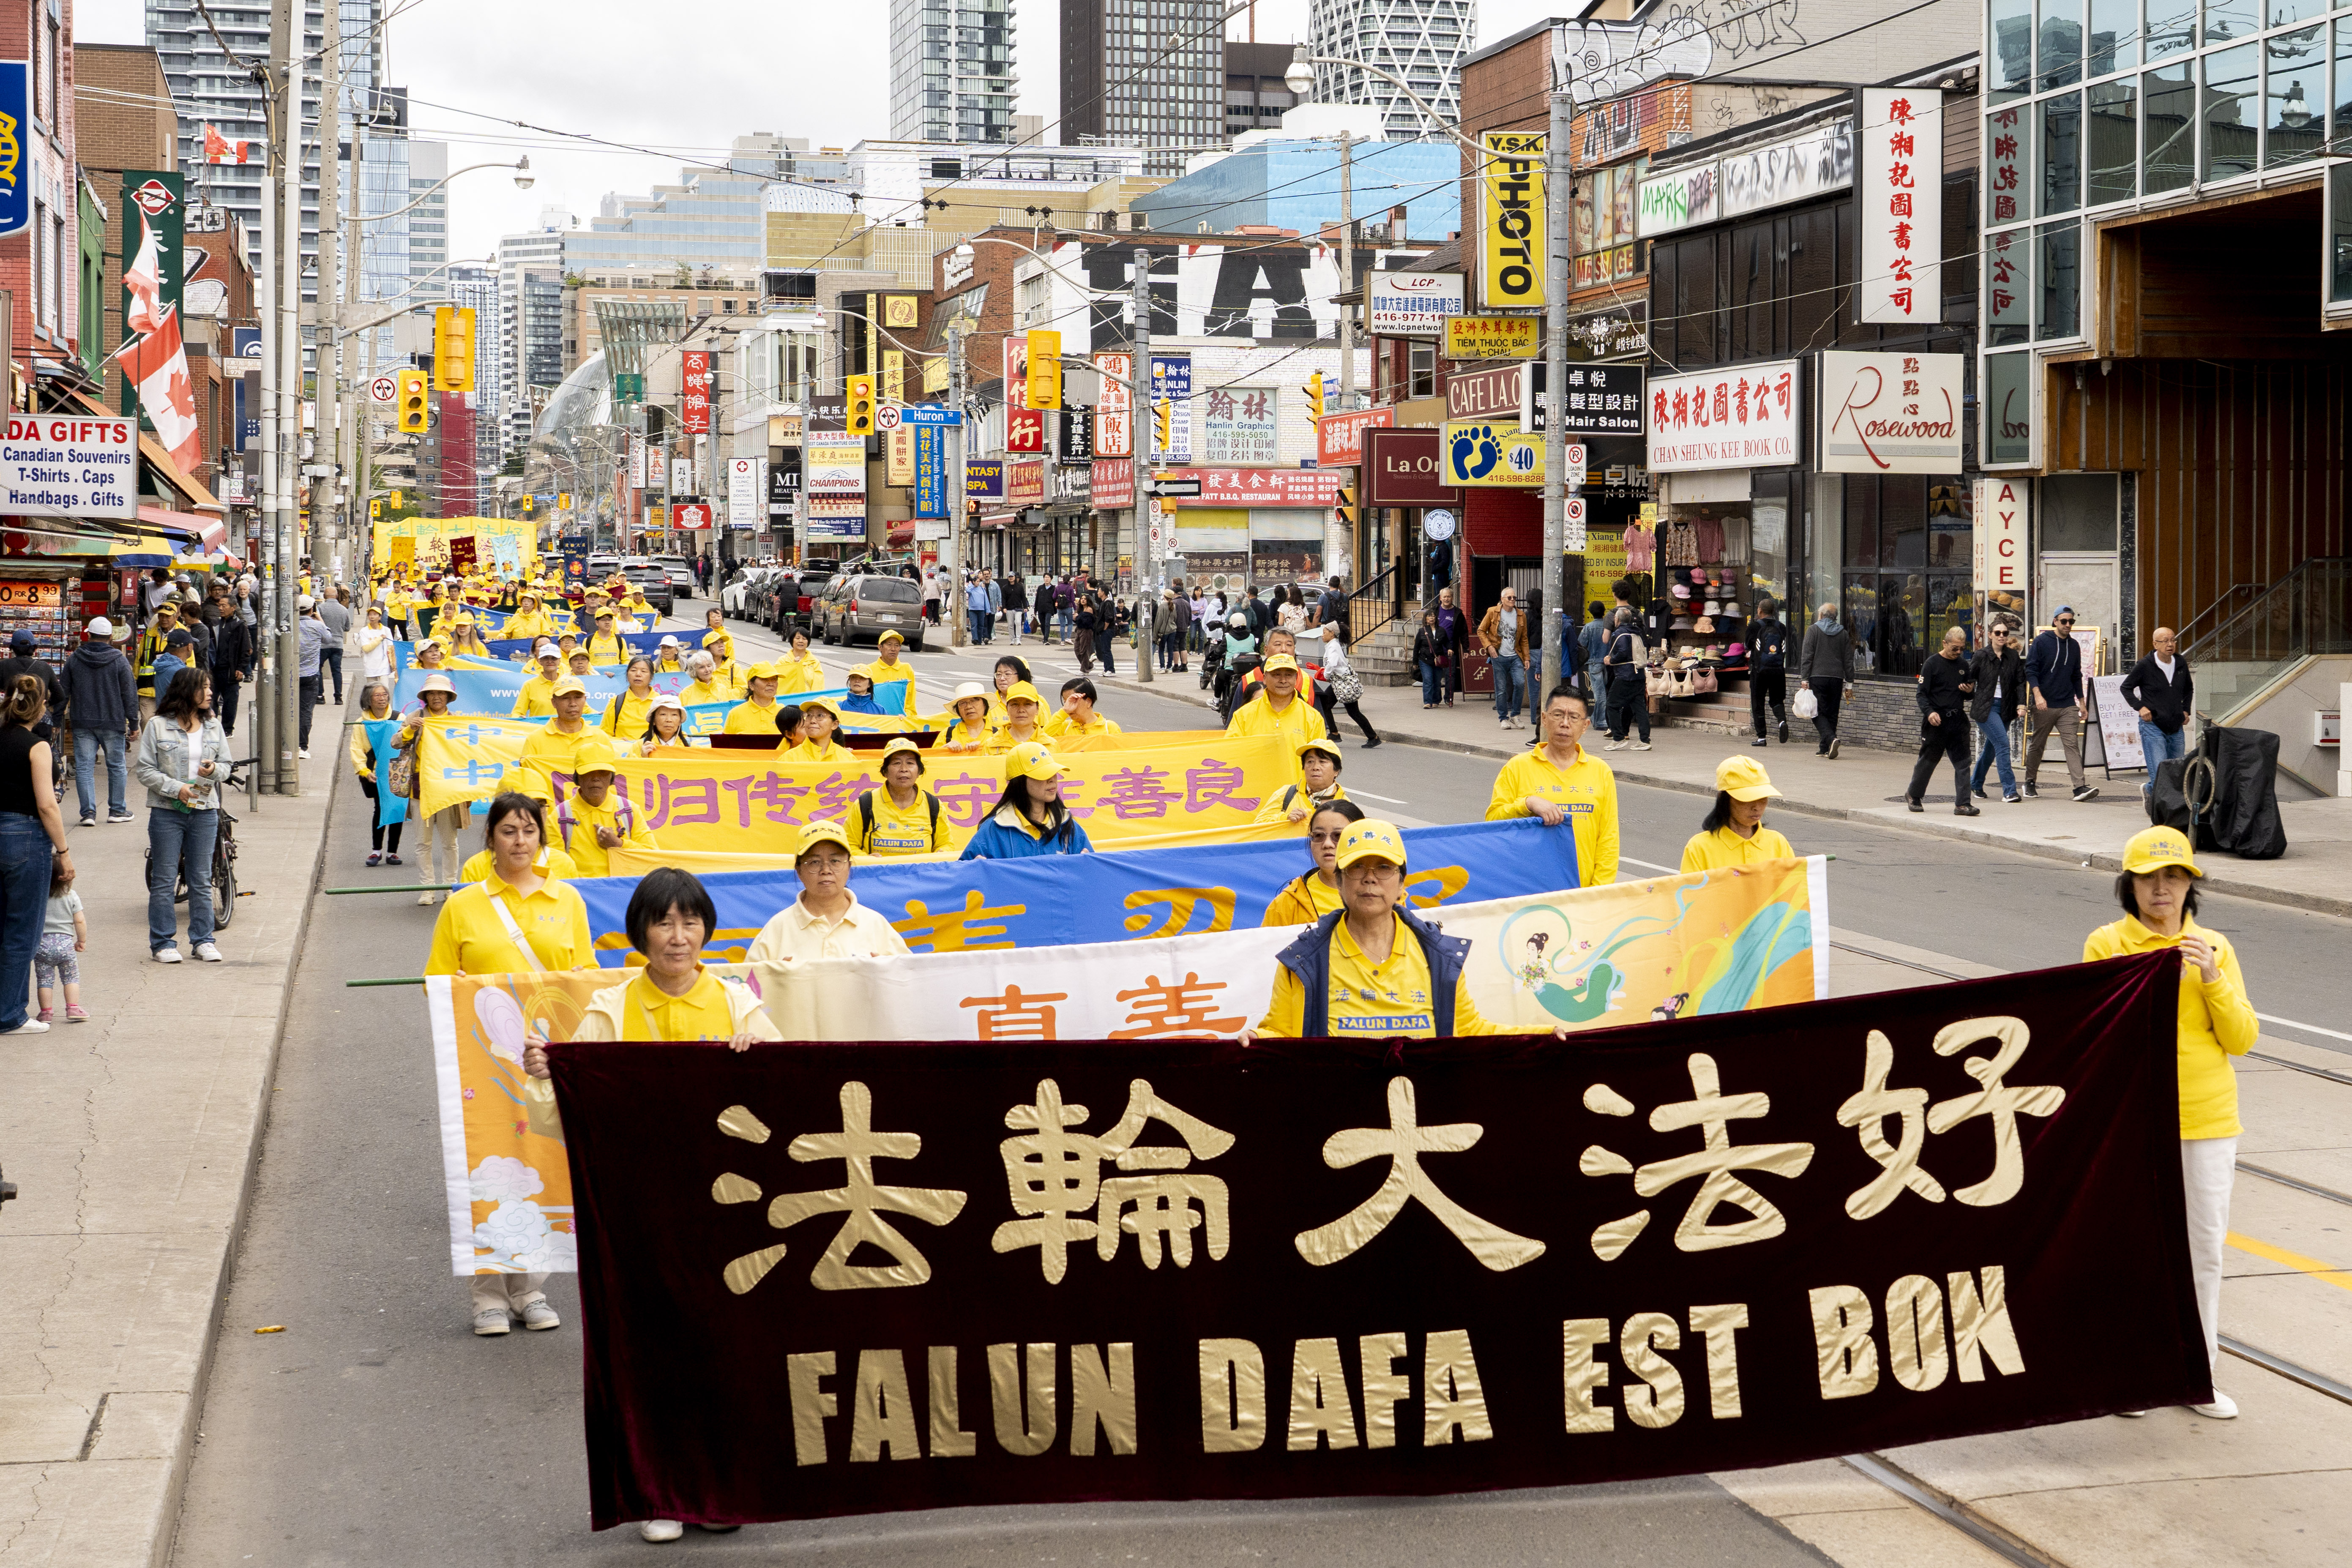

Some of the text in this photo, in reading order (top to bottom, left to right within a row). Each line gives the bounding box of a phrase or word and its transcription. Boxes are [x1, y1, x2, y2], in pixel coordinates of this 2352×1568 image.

[1490, 137, 1543, 152] Y.S.K.
[1888, 97, 1915, 316] 陳湘記圖書公司
[1499, 155, 1532, 295] PHOTO
[1576, 248, 1633, 284] MASSAGE
[1412, 279, 1435, 287] LCP
[1374, 296, 1461, 312] 加拿大宏達通電訊有限公司
[1456, 335, 1529, 348] TIỆM THUỐC BẮC
[1594, 344, 1604, 356] N.B
[1166, 364, 1191, 377] 翰林
[1902, 357, 1920, 415] 點點心
[1450, 377, 1485, 414] CAFE
[1535, 392, 1639, 411] 專髮型設計
[1654, 372, 1792, 434] 陳湘記圖書公司
[1207, 390, 1273, 421] 翰林
[914, 410, 944, 421] Huron
[1565, 415, 1639, 427] Hair Salon
[1832, 366, 1956, 469] Rosewood
[50, 422, 127, 443] GIFTS
[1237, 422, 1274, 431] Graphics
[1207, 439, 1274, 448] 招牌 设计 印刷
[1654, 436, 1791, 463] CHAN SHEUNG KEE BOOK CO.
[4, 447, 131, 464] Canadian Souvenirs
[1207, 451, 1274, 460] 复印 名片 图章
[1509, 447, 1533, 470] $40
[18, 467, 114, 486] T-Shirts Caps
[920, 428, 932, 511] 葵花美容養生館
[967, 481, 988, 490] SPA
[10, 490, 123, 508] Handbags Gifts
[1591, 533, 1614, 541] Xiang
[1998, 484, 2016, 584] AYCE
[1256, 569, 1290, 577] 美食軒
[1590, 587, 1609, 596] Special
[2099, 703, 2115, 711] BUY
[1535, 785, 1594, 794] 法輪大法
[1336, 989, 1426, 1003] 法輪大法
[1341, 1017, 1427, 1028] FALUN DAFA
[712, 1016, 2065, 1295] 法輪大法好
[787, 1341, 1138, 1467] FALUN
[1200, 1329, 1494, 1453] DAFA
[1563, 1303, 1749, 1433] EST
